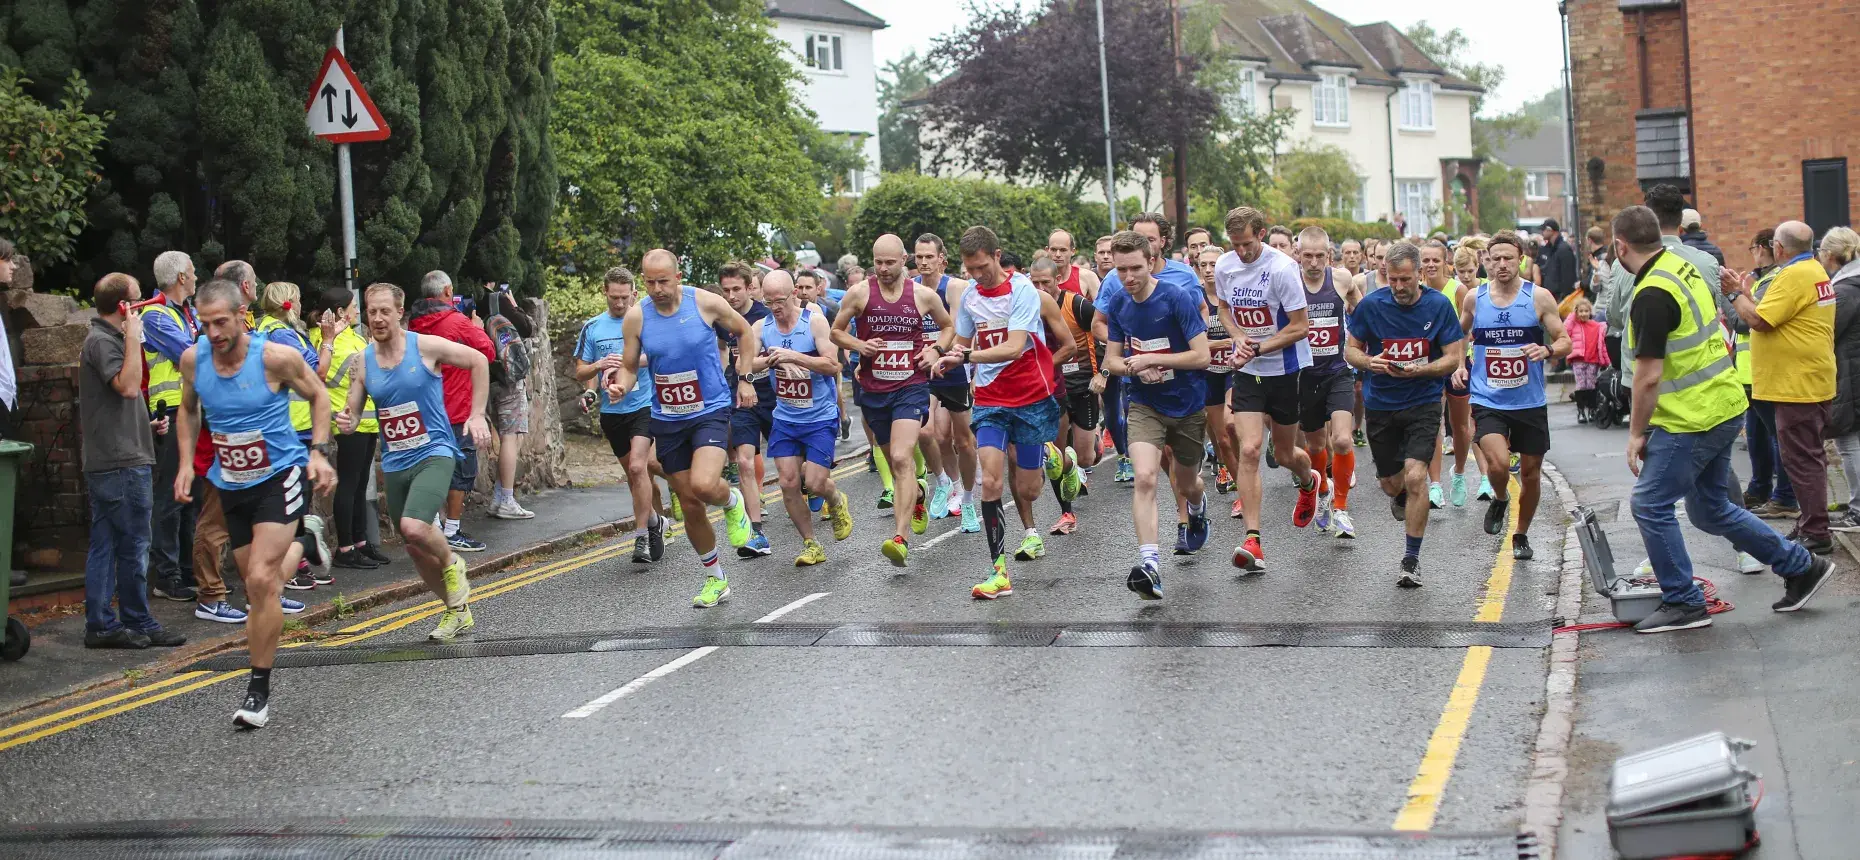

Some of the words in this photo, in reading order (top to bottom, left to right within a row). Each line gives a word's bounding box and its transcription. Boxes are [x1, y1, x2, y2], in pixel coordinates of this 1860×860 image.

[1233, 287, 1263, 298] Stilton
[1231, 297, 1268, 307] Striders
[1308, 303, 1335, 311] EPSHED
[867, 316, 919, 325] ROADHOGGS
[1238, 310, 1266, 325] 110
[871, 325, 912, 333] LEICESTER
[1484, 330, 1505, 339] WEST
[1507, 329, 1524, 337] END
[985, 332, 1004, 348] 17
[1211, 350, 1233, 365] 45
[1388, 341, 1423, 359] 441
[874, 353, 911, 368] 444
[1489, 360, 1525, 377] 630
[661, 385, 697, 403] 618
[778, 381, 809, 397] 540
[384, 416, 420, 439] 649
[218, 446, 264, 469] 589
